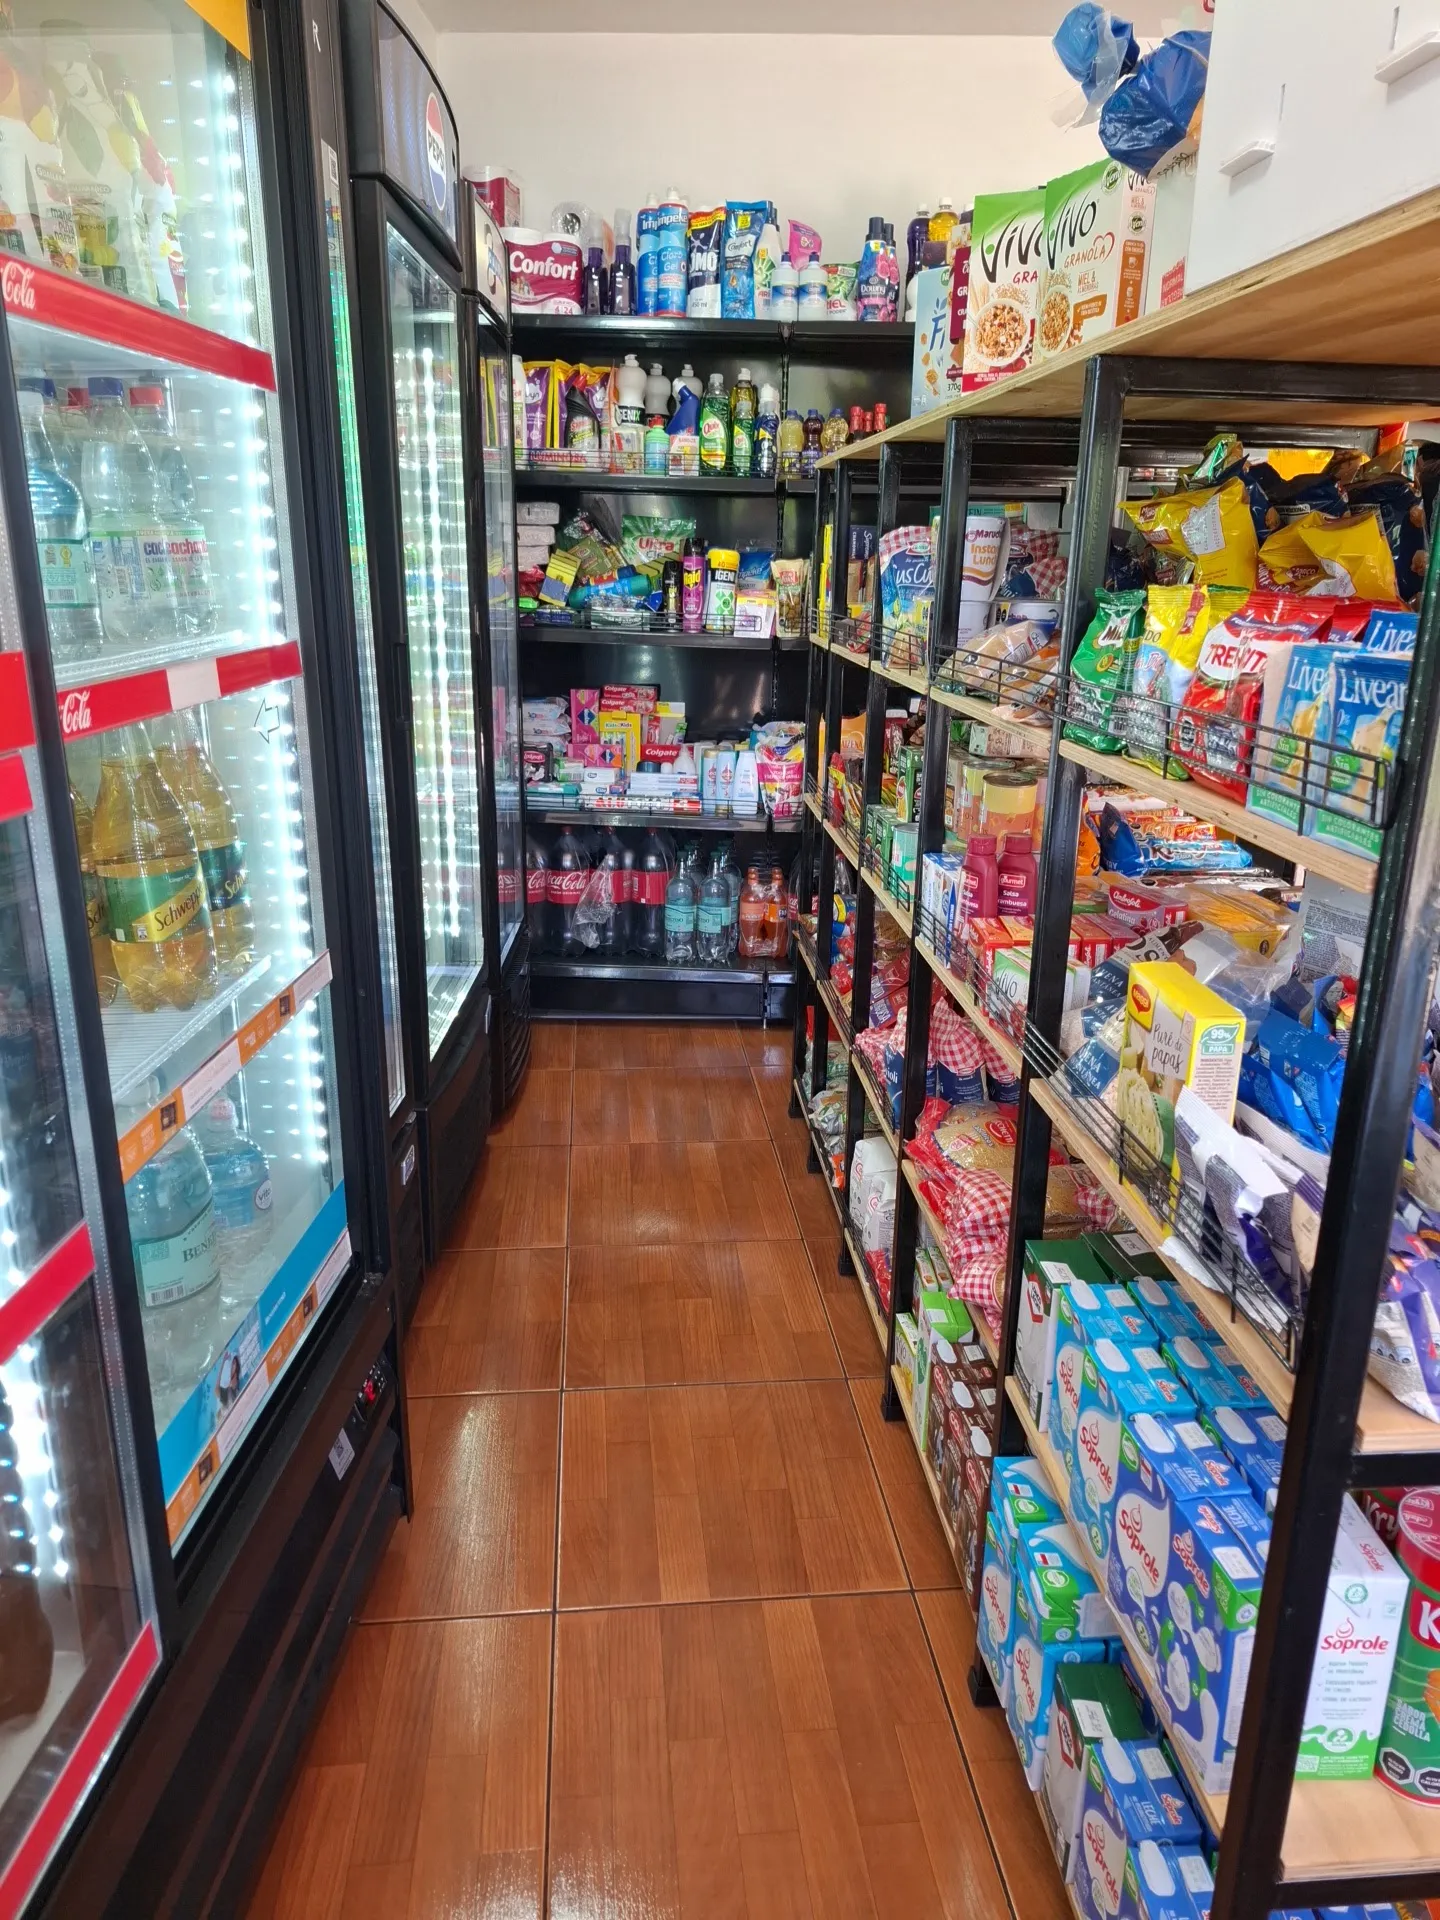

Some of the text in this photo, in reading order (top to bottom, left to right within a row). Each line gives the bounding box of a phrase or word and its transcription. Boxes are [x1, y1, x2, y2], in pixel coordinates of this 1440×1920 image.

[509, 251, 578, 280] Confort
[661, 251, 682, 261] Cloro
[663, 261, 678, 271] Gel
[1064, 245, 1107, 268] GRANOLA
[860, 284, 886, 294] Downy
[1078, 273, 1090, 287] MIEL
[683, 571, 701, 584] Raid
[645, 748, 678, 757] Colgate
[1000, 877, 1025, 887] gourmet
[1003, 890, 1020, 898] Salsa
[1109, 908, 1136, 925] Gelatina
[1133, 988, 1149, 1007] Maggi
[1153, 1023, 1184, 1053] Puré de
[1211, 1029, 1231, 1039] 99%
[1208, 1045, 1228, 1053] PAPA
[1152, 1046, 1184, 1075] papas
[1080, 1425, 1113, 1488] Soprole
[1183, 1466, 1206, 1487] LECHE
[1119, 1508, 1160, 1584] Soprole
[1172, 1533, 1209, 1597] Soprole
[985, 1577, 1007, 1631] Soprole
[1321, 1635, 1389, 1654] Soprole
[1016, 1648, 1035, 1711] Soprole
[1396, 1697, 1426, 1718] SABOR
[1393, 1716, 1431, 1742] CEBOLLA
[1395, 1708, 1426, 1732] CREMA
[1141, 1800, 1161, 1826] LECHE
[1085, 1821, 1120, 1904] Soprole
